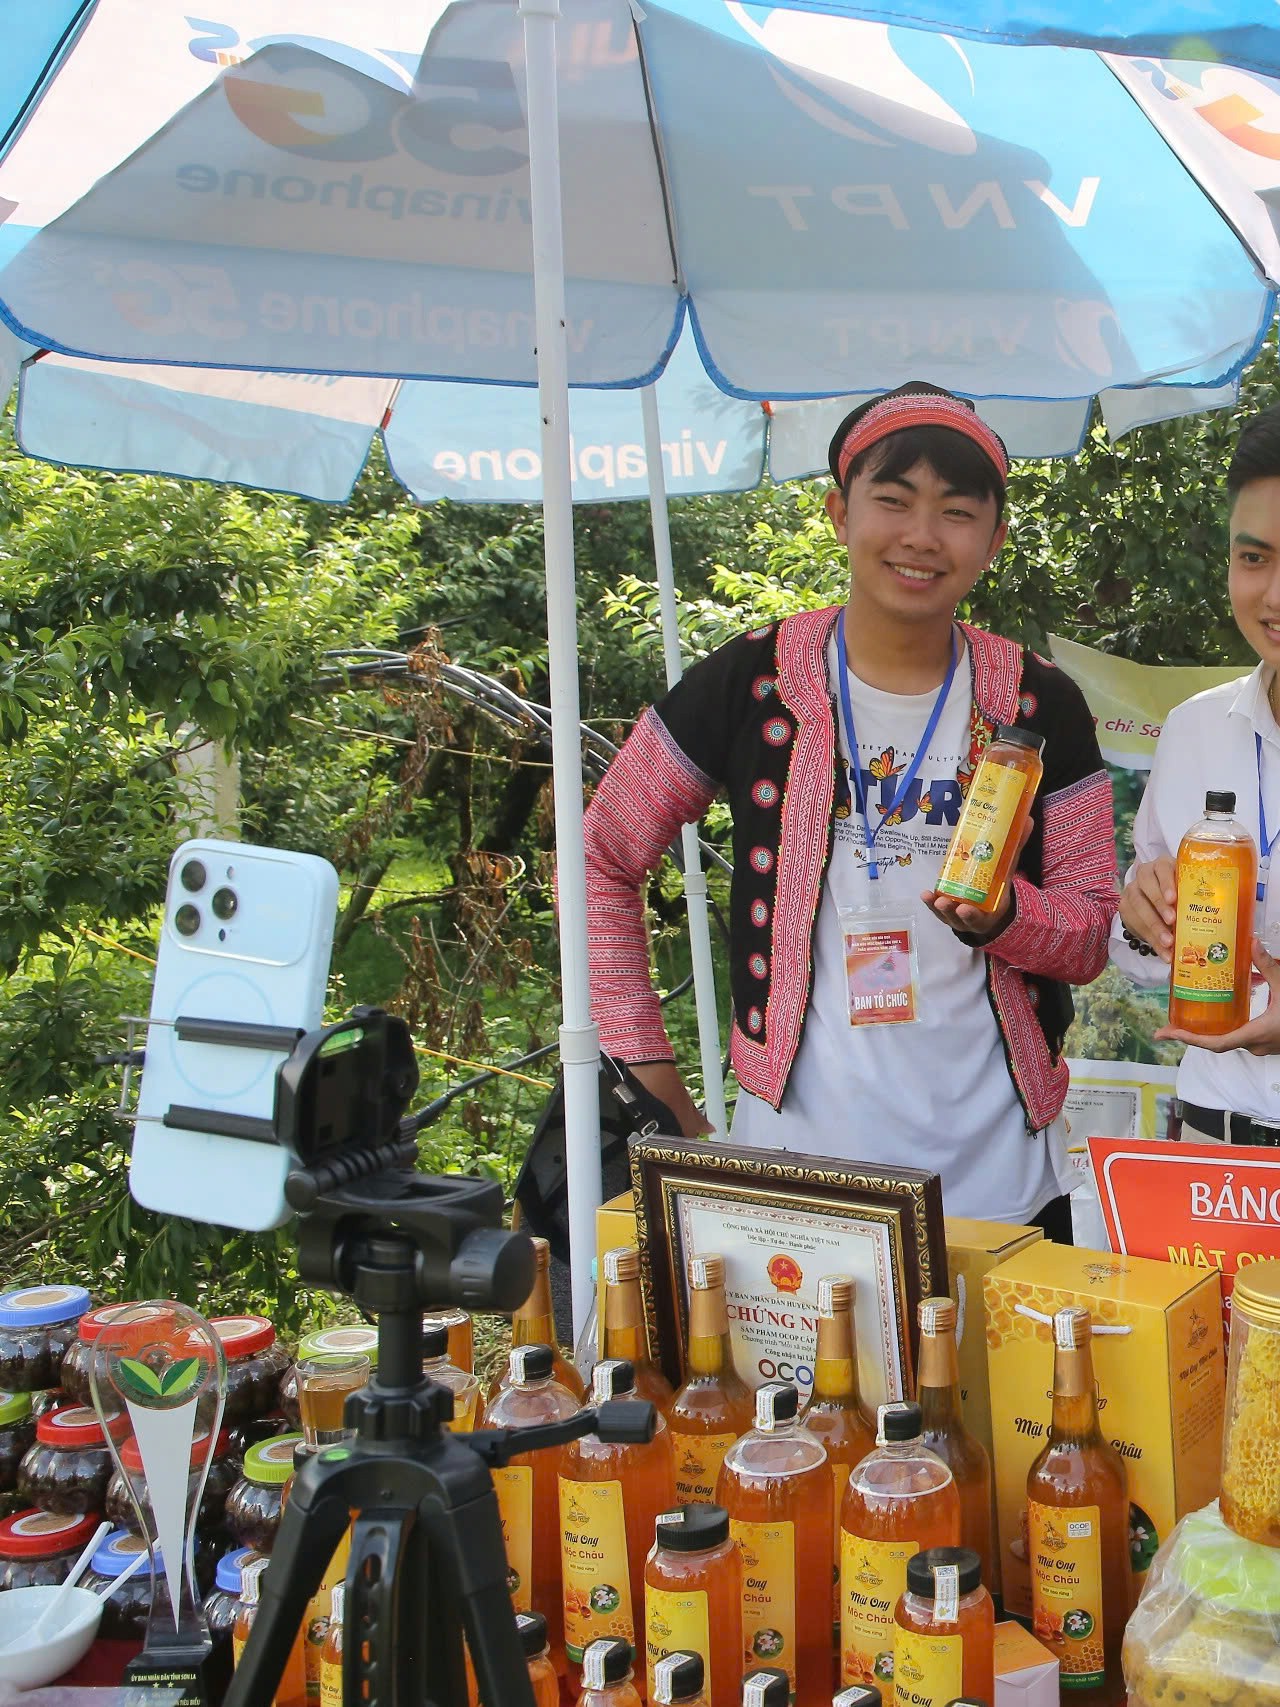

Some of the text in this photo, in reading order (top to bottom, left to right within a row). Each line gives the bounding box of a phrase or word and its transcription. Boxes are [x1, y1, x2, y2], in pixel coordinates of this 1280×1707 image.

[1105, 718, 1134, 735] chỉ:
[1202, 916, 1222, 924] Châu
[855, 989, 908, 1010] BAN TỔ CHỨC
[726, 1304, 796, 1329] CHỨNG
[1014, 1417, 1143, 1460] Mật Châu
[676, 1482, 713, 1496] Mật Ong
[580, 1535, 599, 1547] Ong
[578, 1550, 604, 1560] Châu
[1037, 1554, 1075, 1573] Mật Ong
[746, 1578, 767, 1590] Ong
[1035, 1569, 1080, 1584] Mộc Châu
[743, 1594, 772, 1603] Châu
[850, 1590, 891, 1612] Mật Ong
[848, 1606, 894, 1624] Mộc Châu
[896, 1683, 932, 1707] Mật Ong
